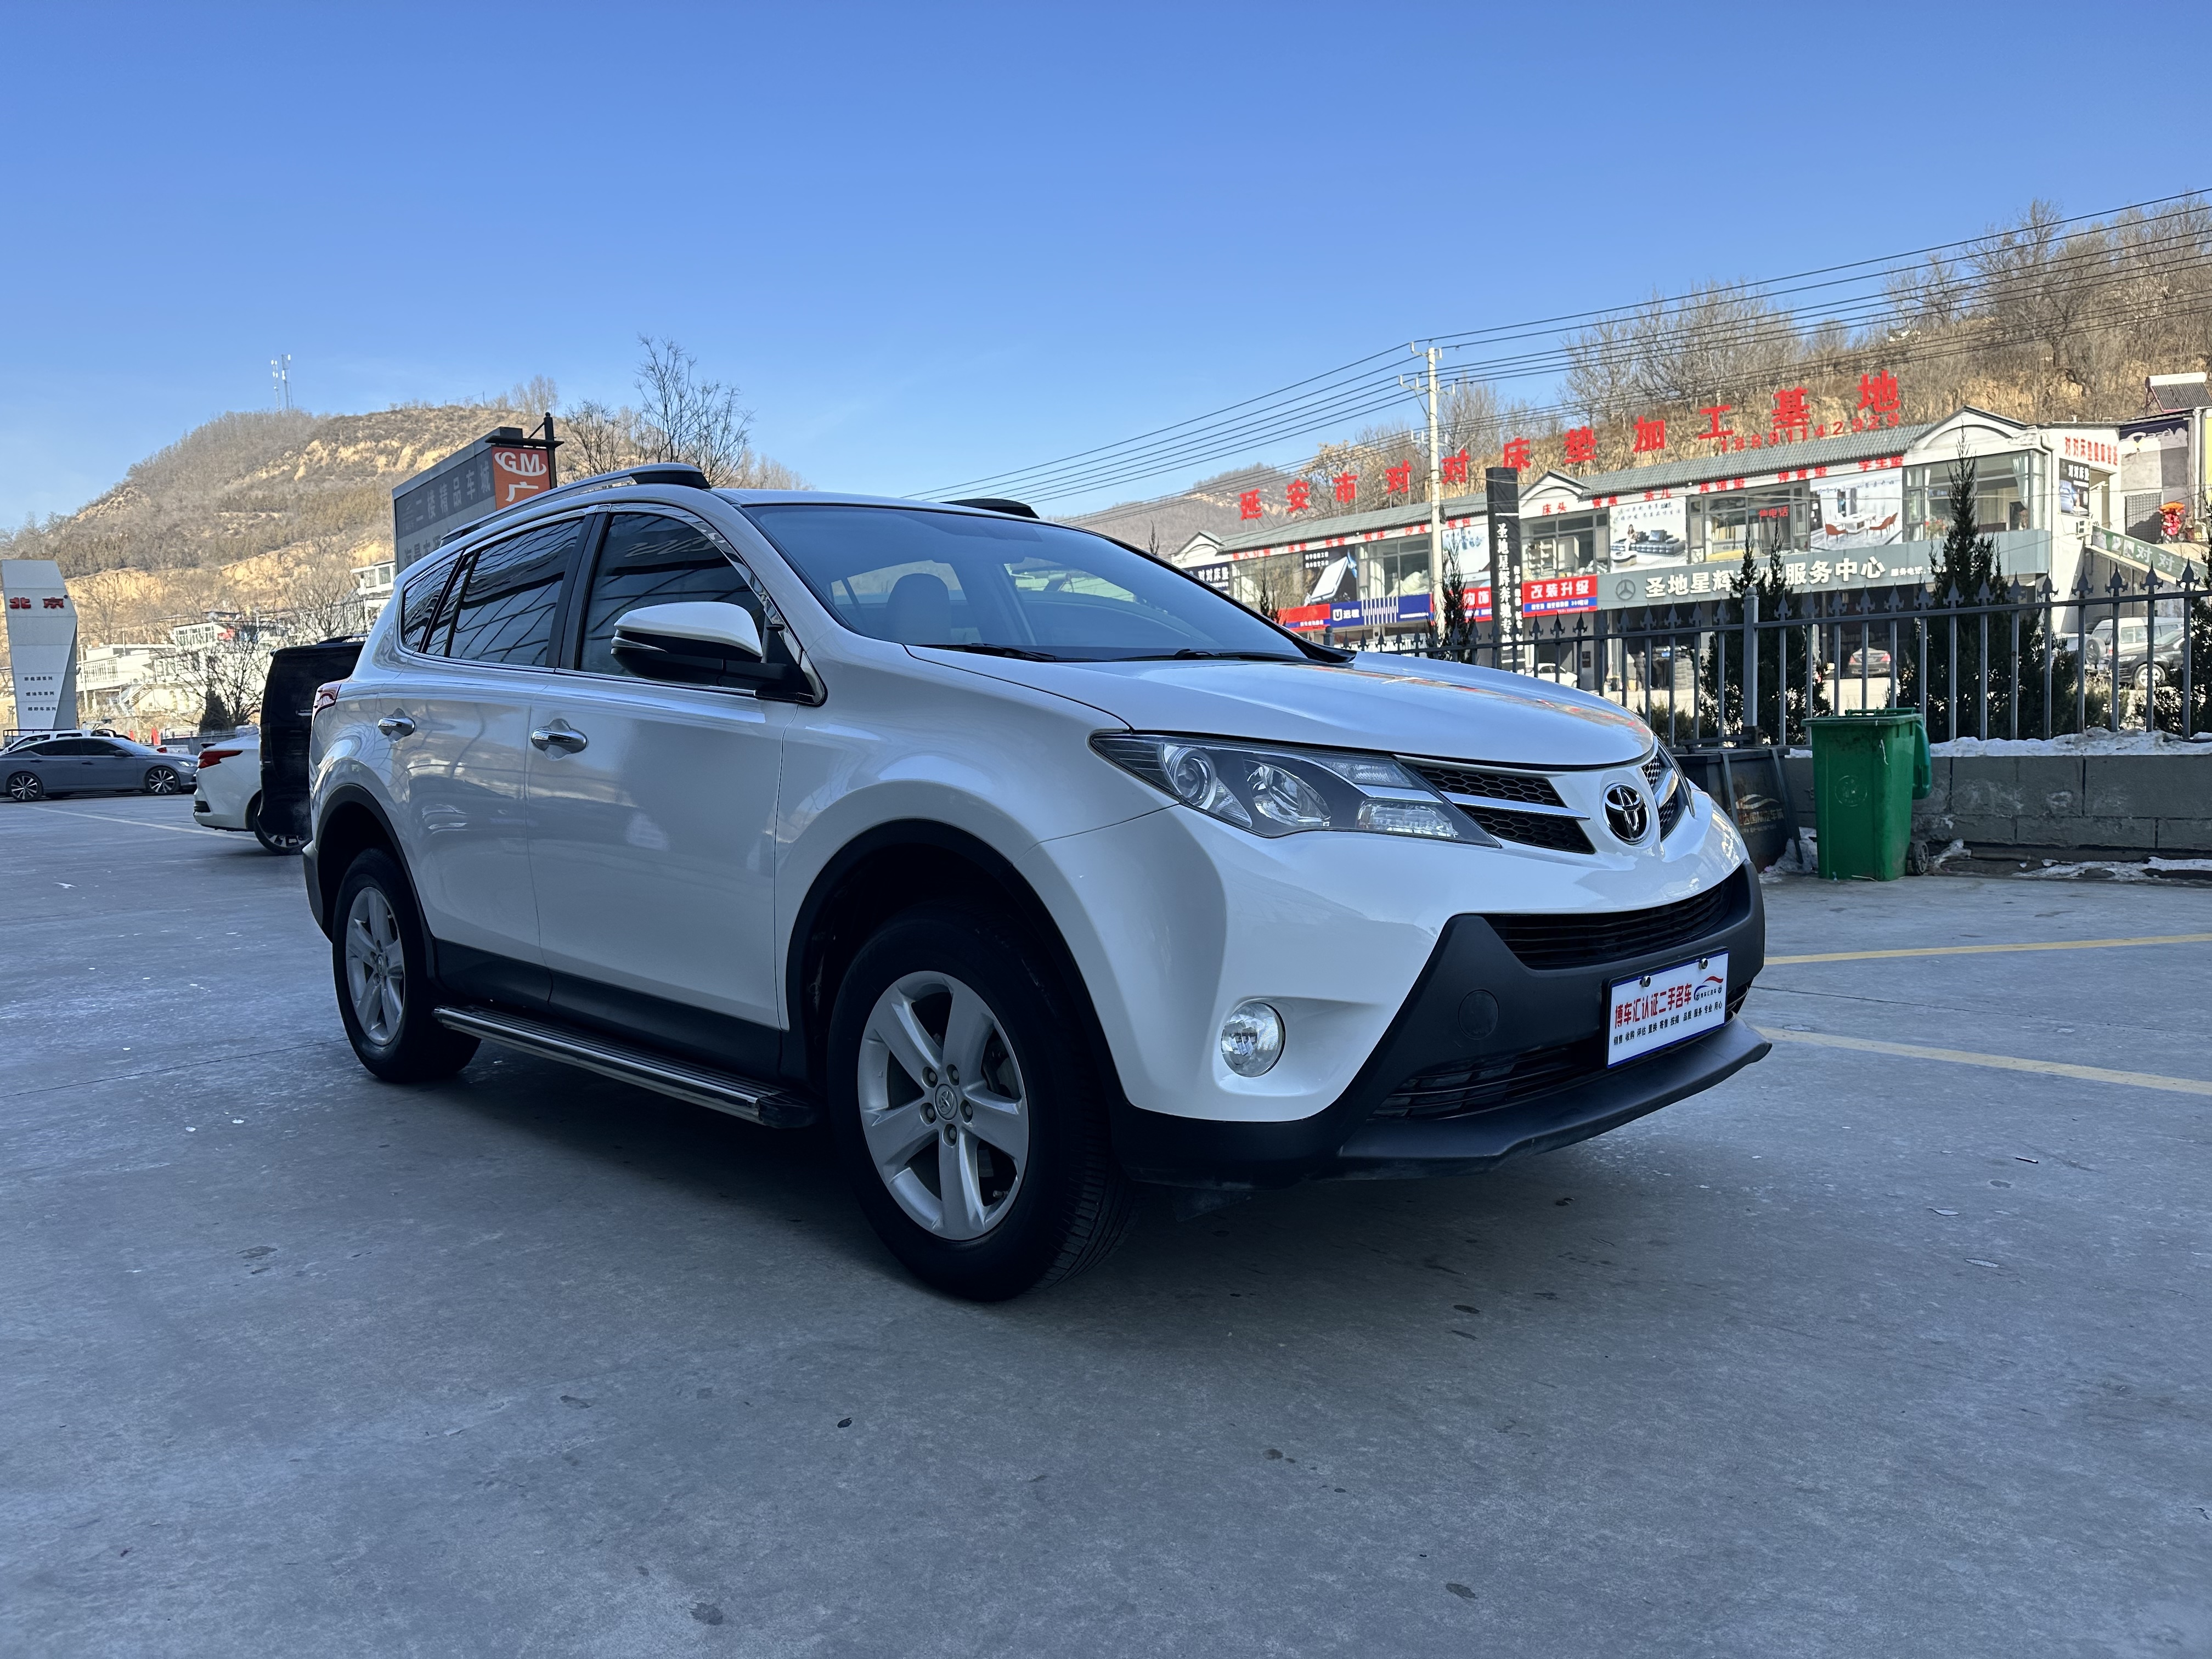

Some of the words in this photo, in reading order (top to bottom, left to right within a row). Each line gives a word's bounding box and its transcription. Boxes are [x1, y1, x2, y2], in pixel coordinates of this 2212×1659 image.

[1239, 369, 1901, 520] 延安市对对床垫加工基地
[1720, 413, 1899, 452] 18891142929
[500, 451, 540, 474] GM
[1542, 501, 1567, 516] 床头
[1644, 488, 1671, 501] 茶几
[1858, 455, 1904, 472] 学生垫
[1531, 579, 1589, 599] 改装升级
[1646, 556, 1886, 598] 圣地星辉服务中心
[9, 597, 64, 609] 北京
[1615, 983, 1692, 1029] 博车汇认证二手名车
[1625, 1030, 1635, 1041] 收购
[1637, 1026, 1646, 1037] 评估
[1648, 1023, 1657, 1034] 置换
[1660, 1019, 1668, 1029] 寄售
[1683, 1010, 1692, 1022] 品质
[1694, 1007, 1702, 1018] 服务
[1705, 1004, 1713, 1013] 专业
[1714, 1001, 1723, 1011] 用心
